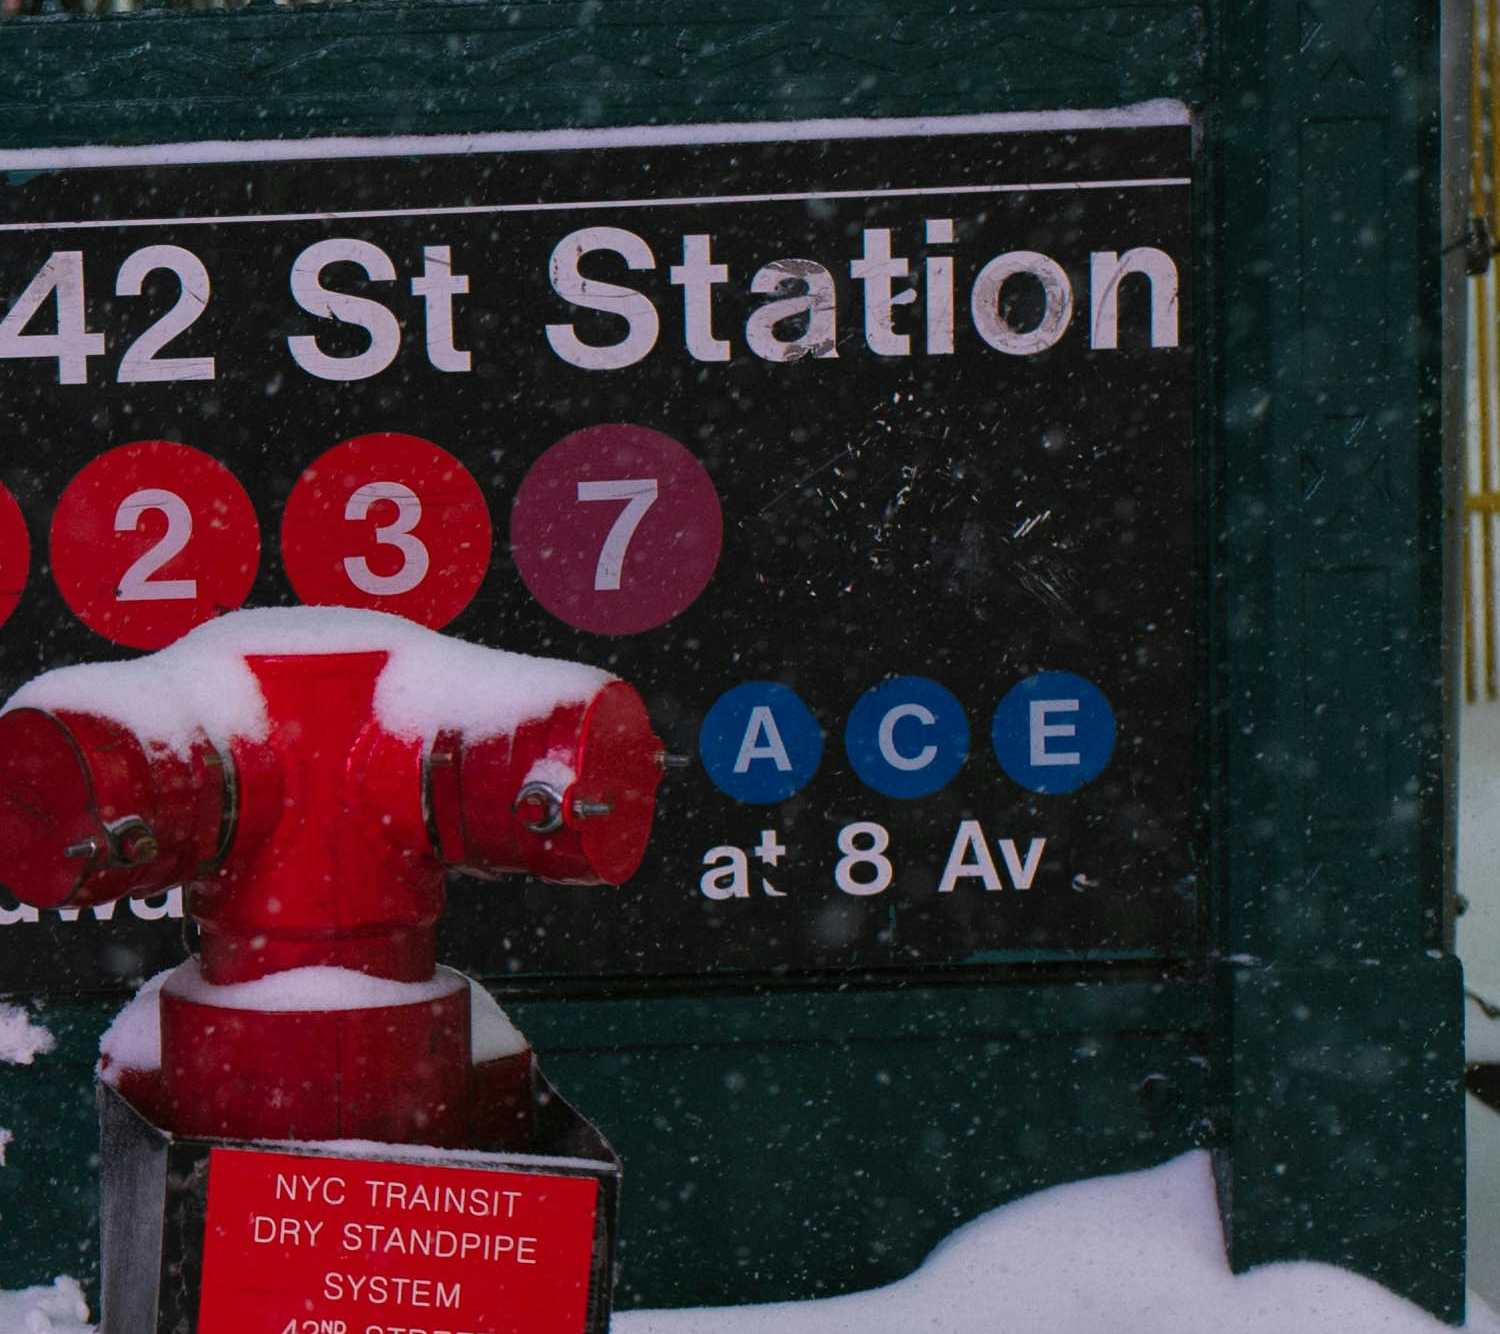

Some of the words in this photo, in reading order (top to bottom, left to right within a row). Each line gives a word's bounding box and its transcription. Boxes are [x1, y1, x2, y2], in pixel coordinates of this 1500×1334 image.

[287, 237, 472, 381] St
[545, 218, 1179, 371] Station
[112, 488, 198, 602] 2
[342, 481, 430, 595] 3
[577, 478, 659, 590] 7
[733, 706, 793, 773] A
[878, 703, 938, 771] C
[1029, 698, 1081, 766] E
[701, 830, 787, 900] at
[834, 821, 893, 897] 8
[938, 819, 1047, 892] Av
[276, 1174, 346, 1205] NYC
[366, 1180, 522, 1218] TRAINSIT
[254, 1216, 324, 1247] DRY
[342, 1223, 537, 1265] STANDPIPE
[324, 1272, 461, 1308] SYSTEM
